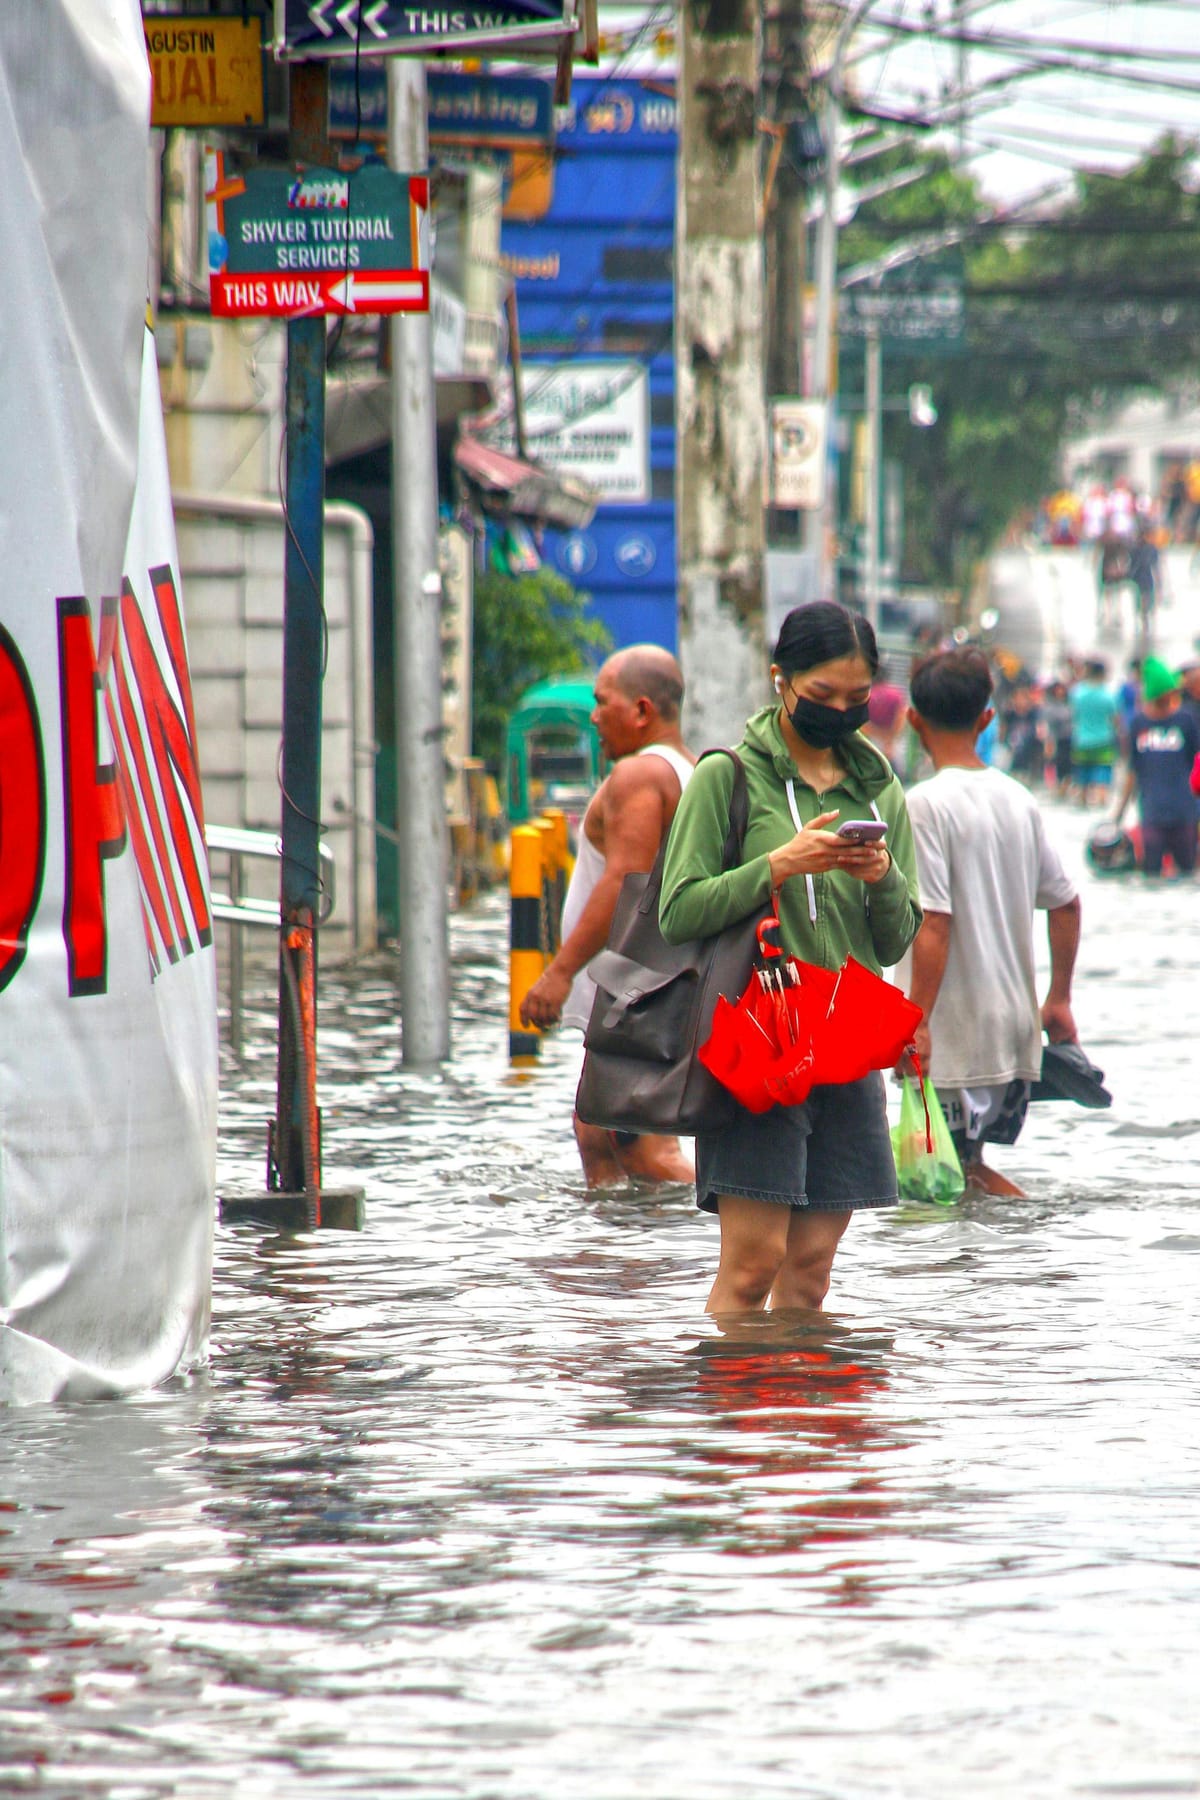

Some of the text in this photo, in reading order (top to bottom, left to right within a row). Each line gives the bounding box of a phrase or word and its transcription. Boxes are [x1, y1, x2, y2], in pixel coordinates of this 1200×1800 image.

[404, 8, 466, 33] THIS
[242, 216, 394, 243] SKYLER TUTORIAL
[277, 244, 360, 269] SERVICES
[223, 280, 321, 307] THIS WAY
